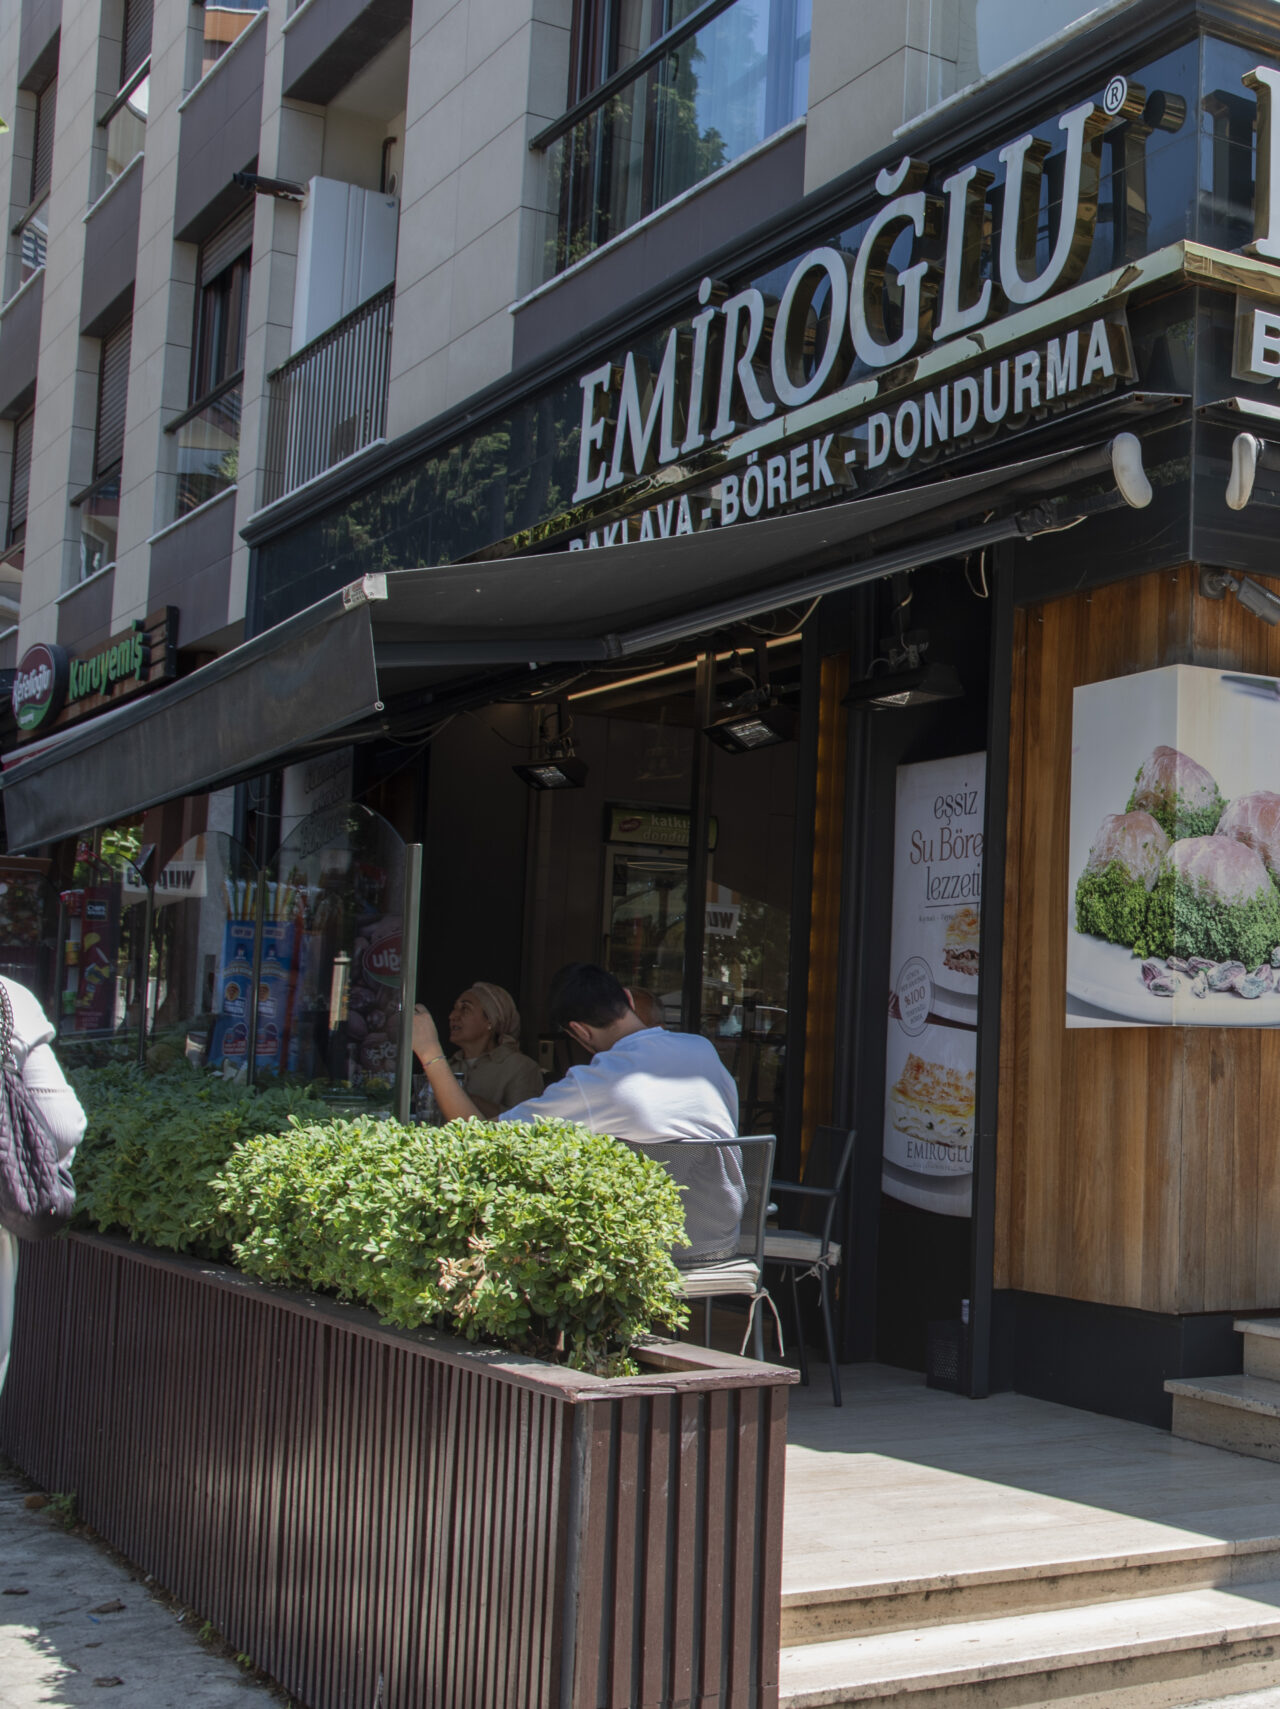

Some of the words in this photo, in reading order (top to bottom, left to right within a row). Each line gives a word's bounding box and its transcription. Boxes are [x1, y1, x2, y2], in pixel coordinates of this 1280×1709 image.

[721, 433, 835, 525] BÖREK
[867, 319, 1114, 471] DONDURMA
[69, 619, 144, 700] Kuruyemiş
[934, 782, 979, 826] eşsiz
[910, 829, 935, 865] Su
[940, 826, 984, 862] Böre
